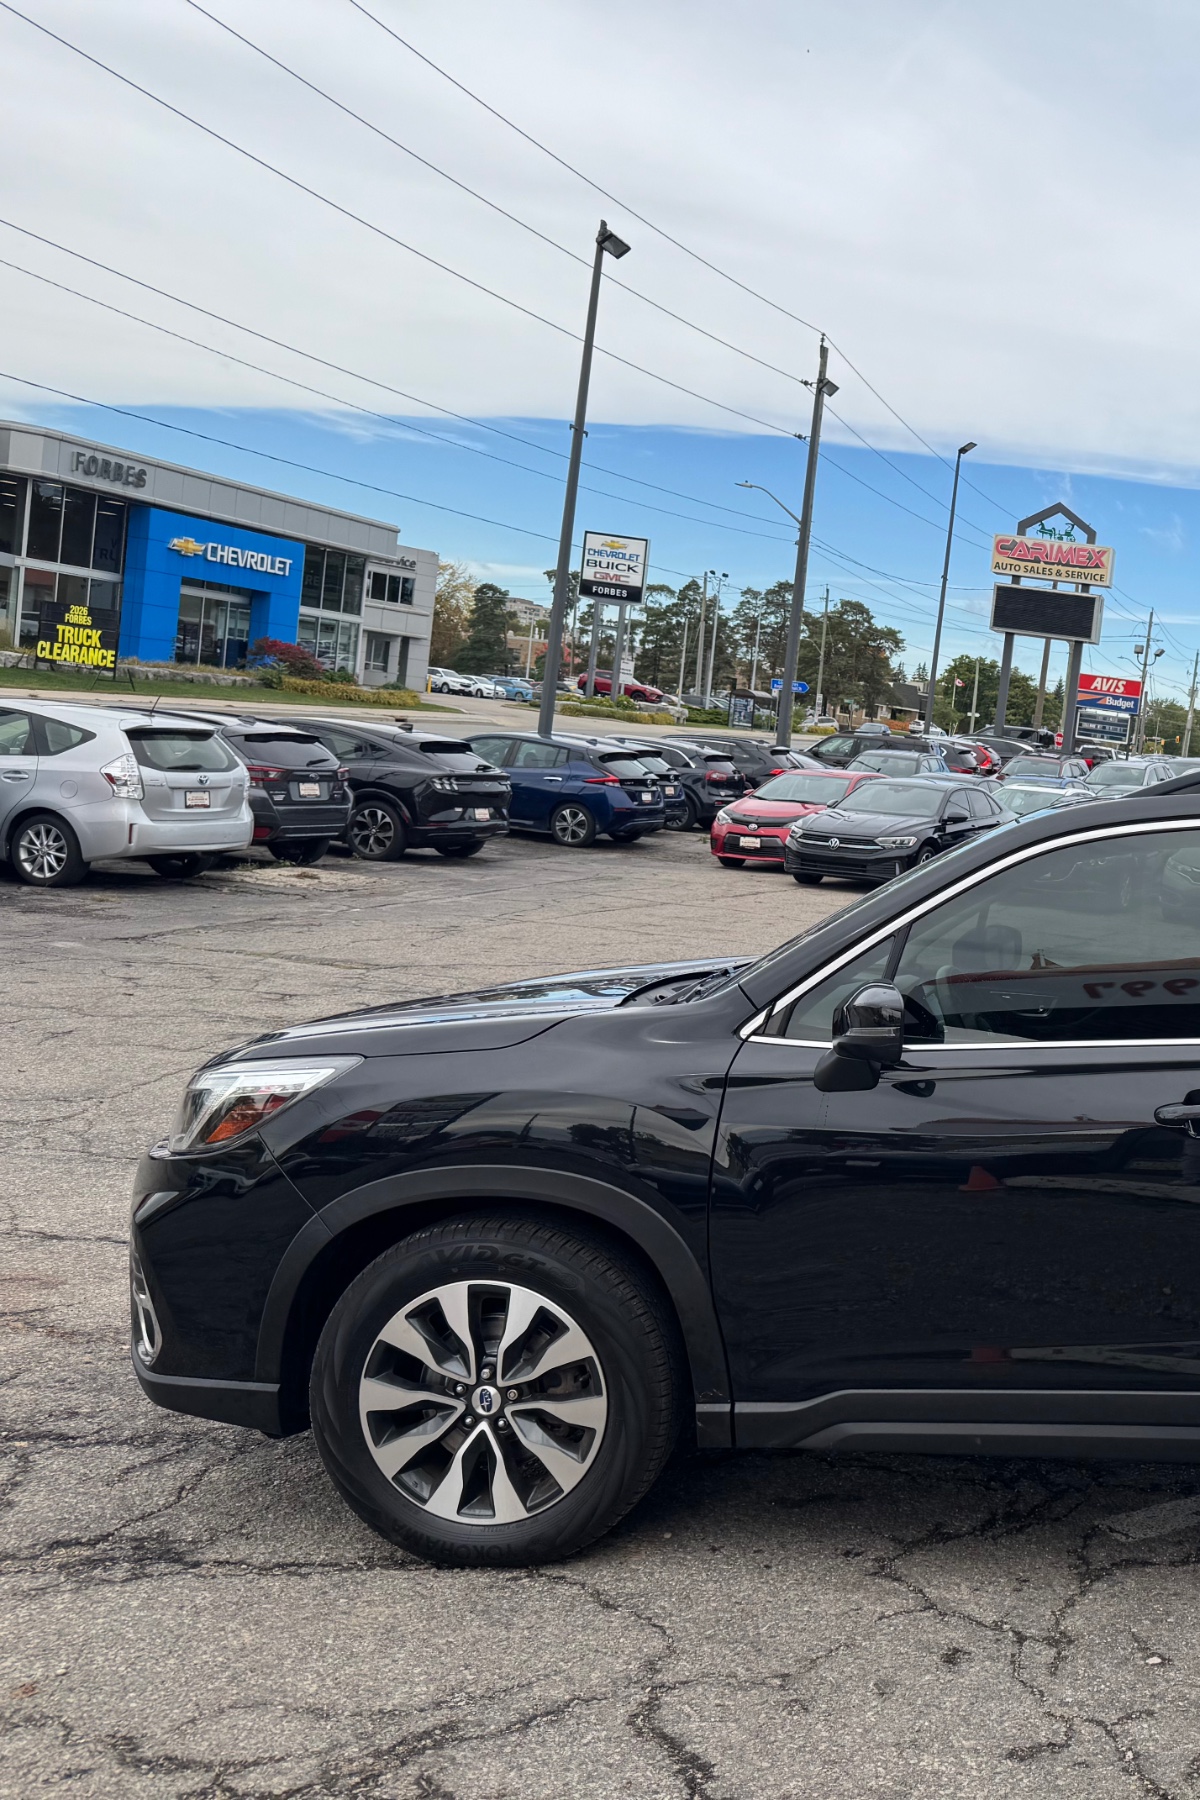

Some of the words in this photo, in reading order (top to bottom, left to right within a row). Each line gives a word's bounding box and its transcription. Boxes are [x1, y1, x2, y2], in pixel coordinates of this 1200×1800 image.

[71, 451, 148, 488] FORBES
[206, 542, 293, 577] CHEVROLET
[587, 547, 640, 562] CHEVROLET
[995, 538, 1108, 568] CARIMEX
[586, 558, 639, 573] BUICK
[994, 561, 1021, 572] AUTO
[1023, 565, 1053, 576] SALES
[1055, 569, 1062, 577] &
[1065, 570, 1105, 581] SERVICE
[593, 571, 630, 583] GMC
[592, 585, 628, 597] FORBES
[69, 604, 88, 616] 2026
[64, 613, 92, 626] FORBES
[56, 624, 102, 648] TRUCK
[36, 640, 116, 668] CLEARANCE
[1090, 677, 1126, 693] AVIS
[1105, 697, 1134, 709] Budget
